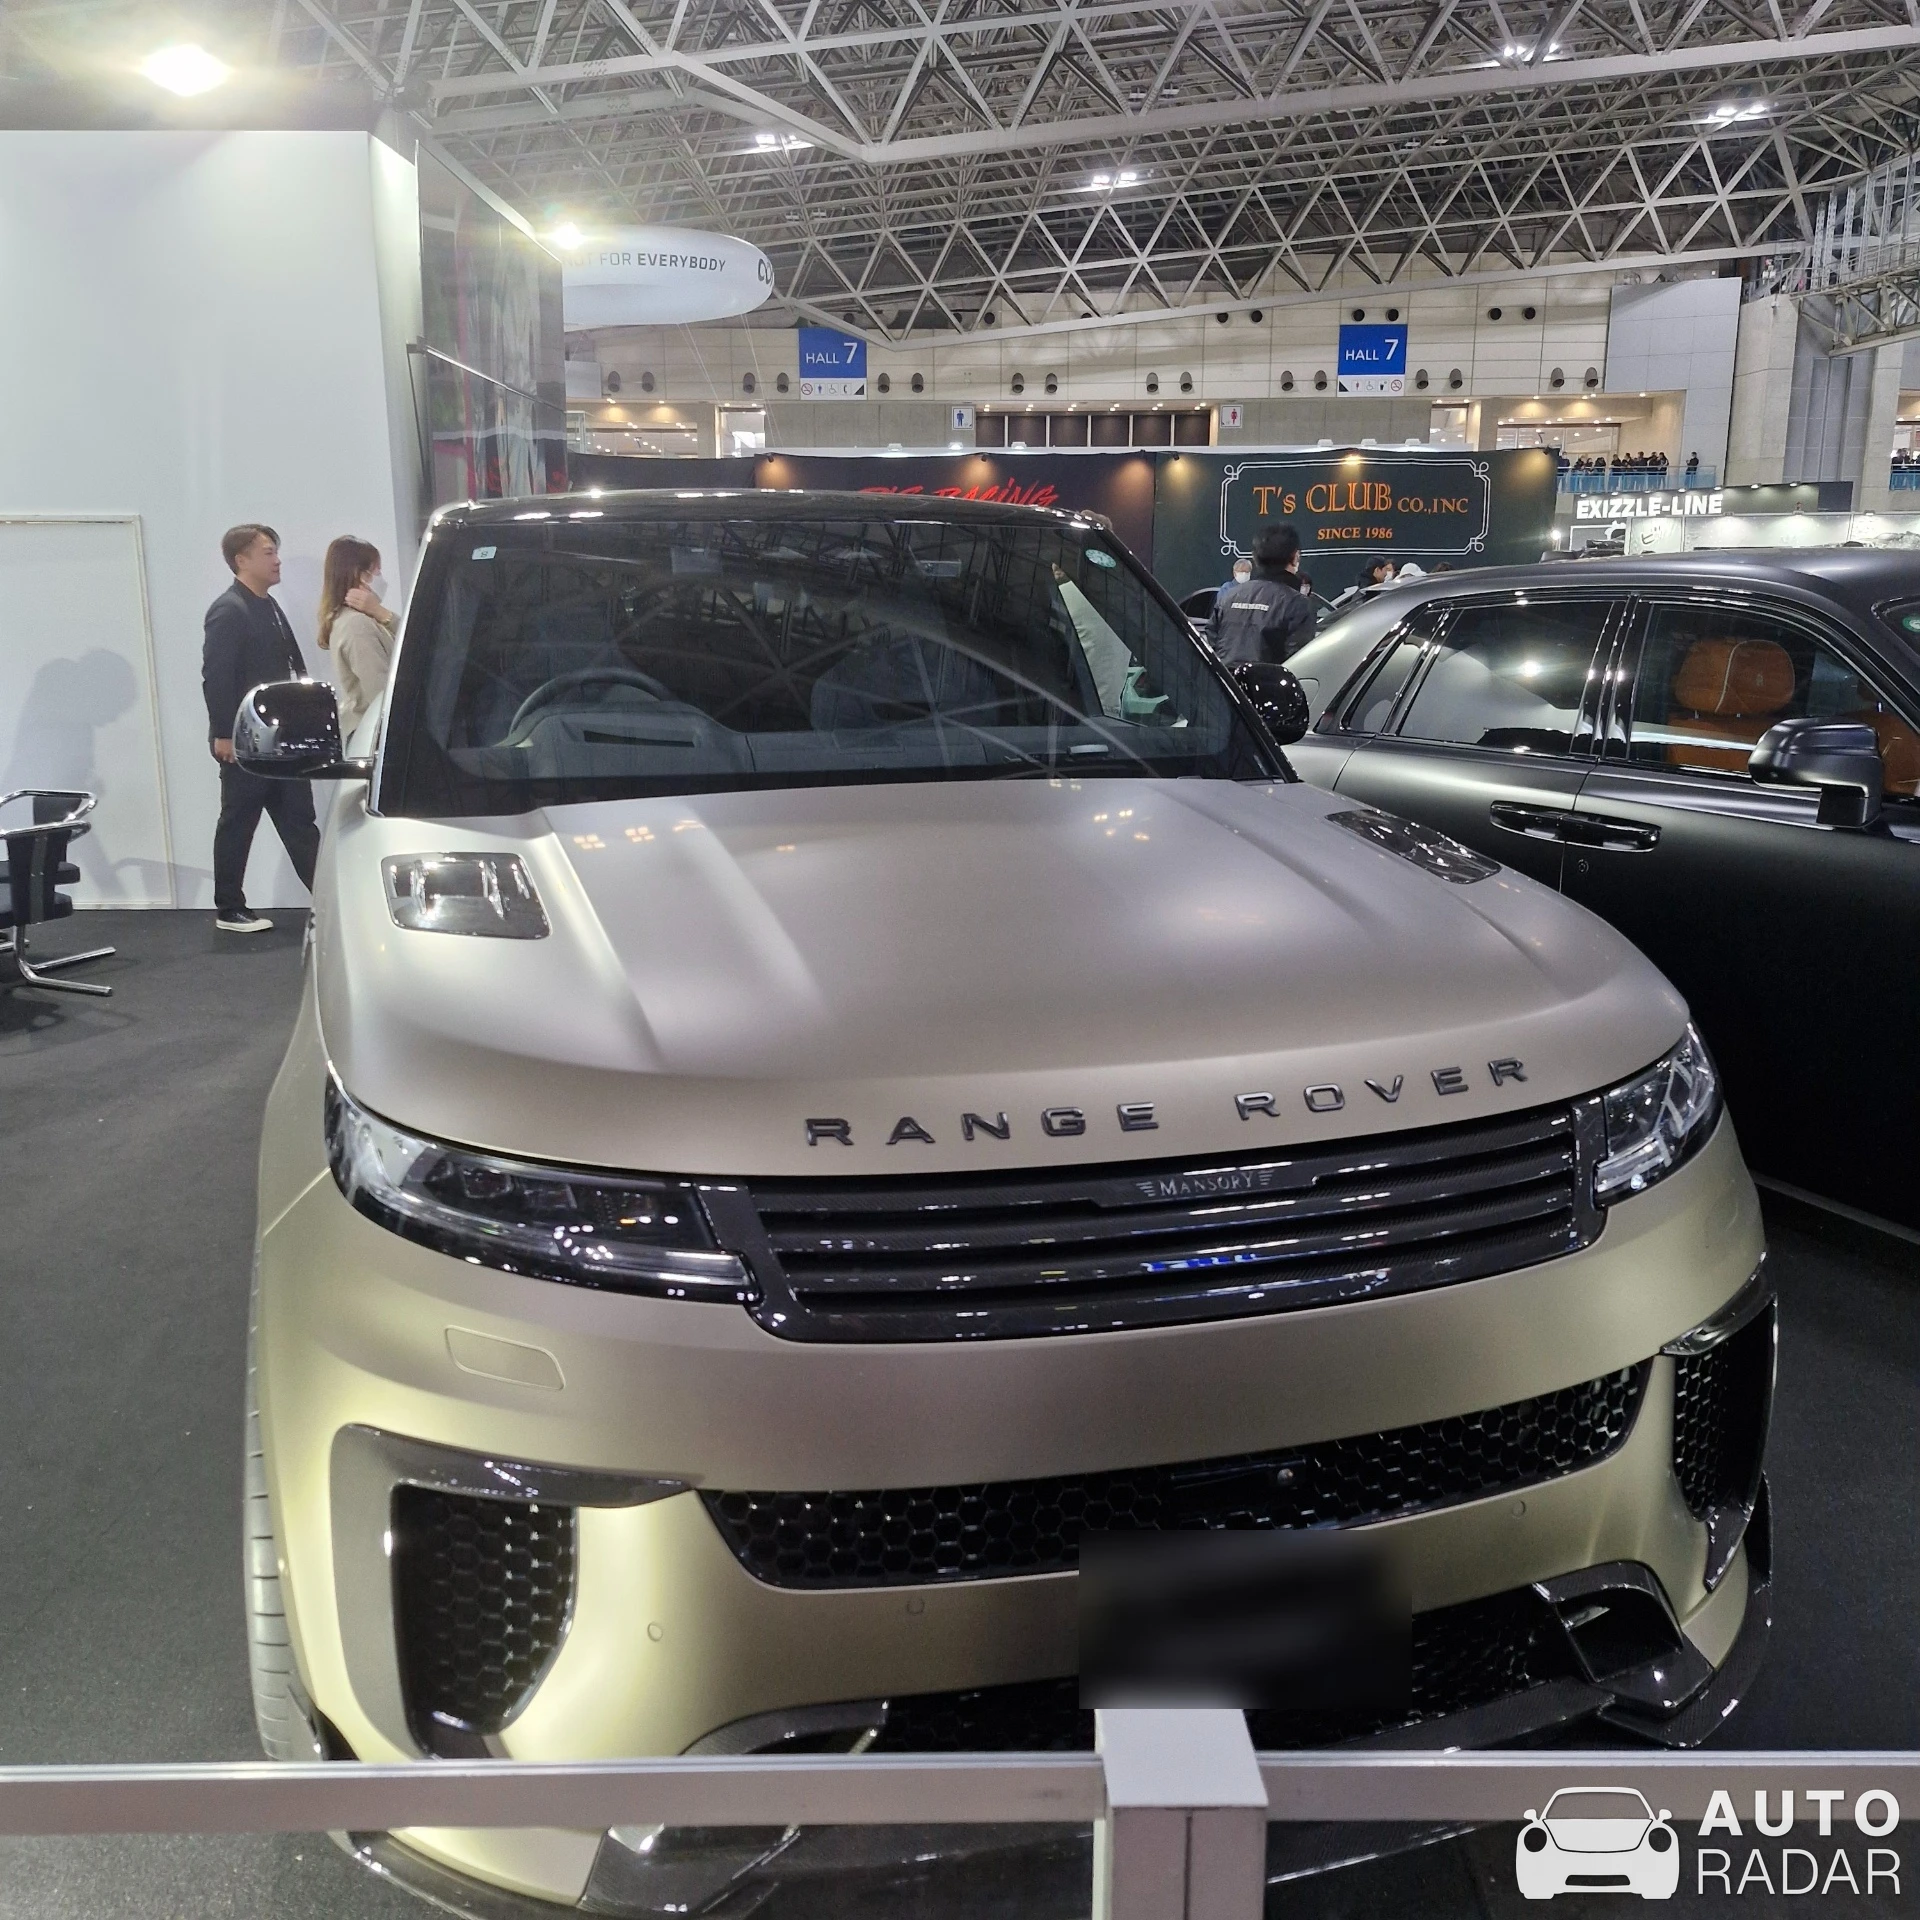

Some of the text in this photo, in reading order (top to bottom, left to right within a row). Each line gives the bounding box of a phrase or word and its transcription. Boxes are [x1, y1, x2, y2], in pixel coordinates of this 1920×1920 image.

[600, 252, 632, 266] FOR
[637, 252, 726, 272] EVERYBODY
[805, 342, 858, 364] HALL 7
[1345, 338, 1399, 361] HALL 7
[1252, 486, 1297, 515] T's
[1305, 482, 1393, 514] CLUB
[1576, 494, 1723, 519] EXIZZLE-LINE
[1317, 527, 1393, 540] SINCE 1986
[806, 1056, 1530, 1148] RANGE ROVER
[1158, 1171, 1254, 1197] MANSORY
